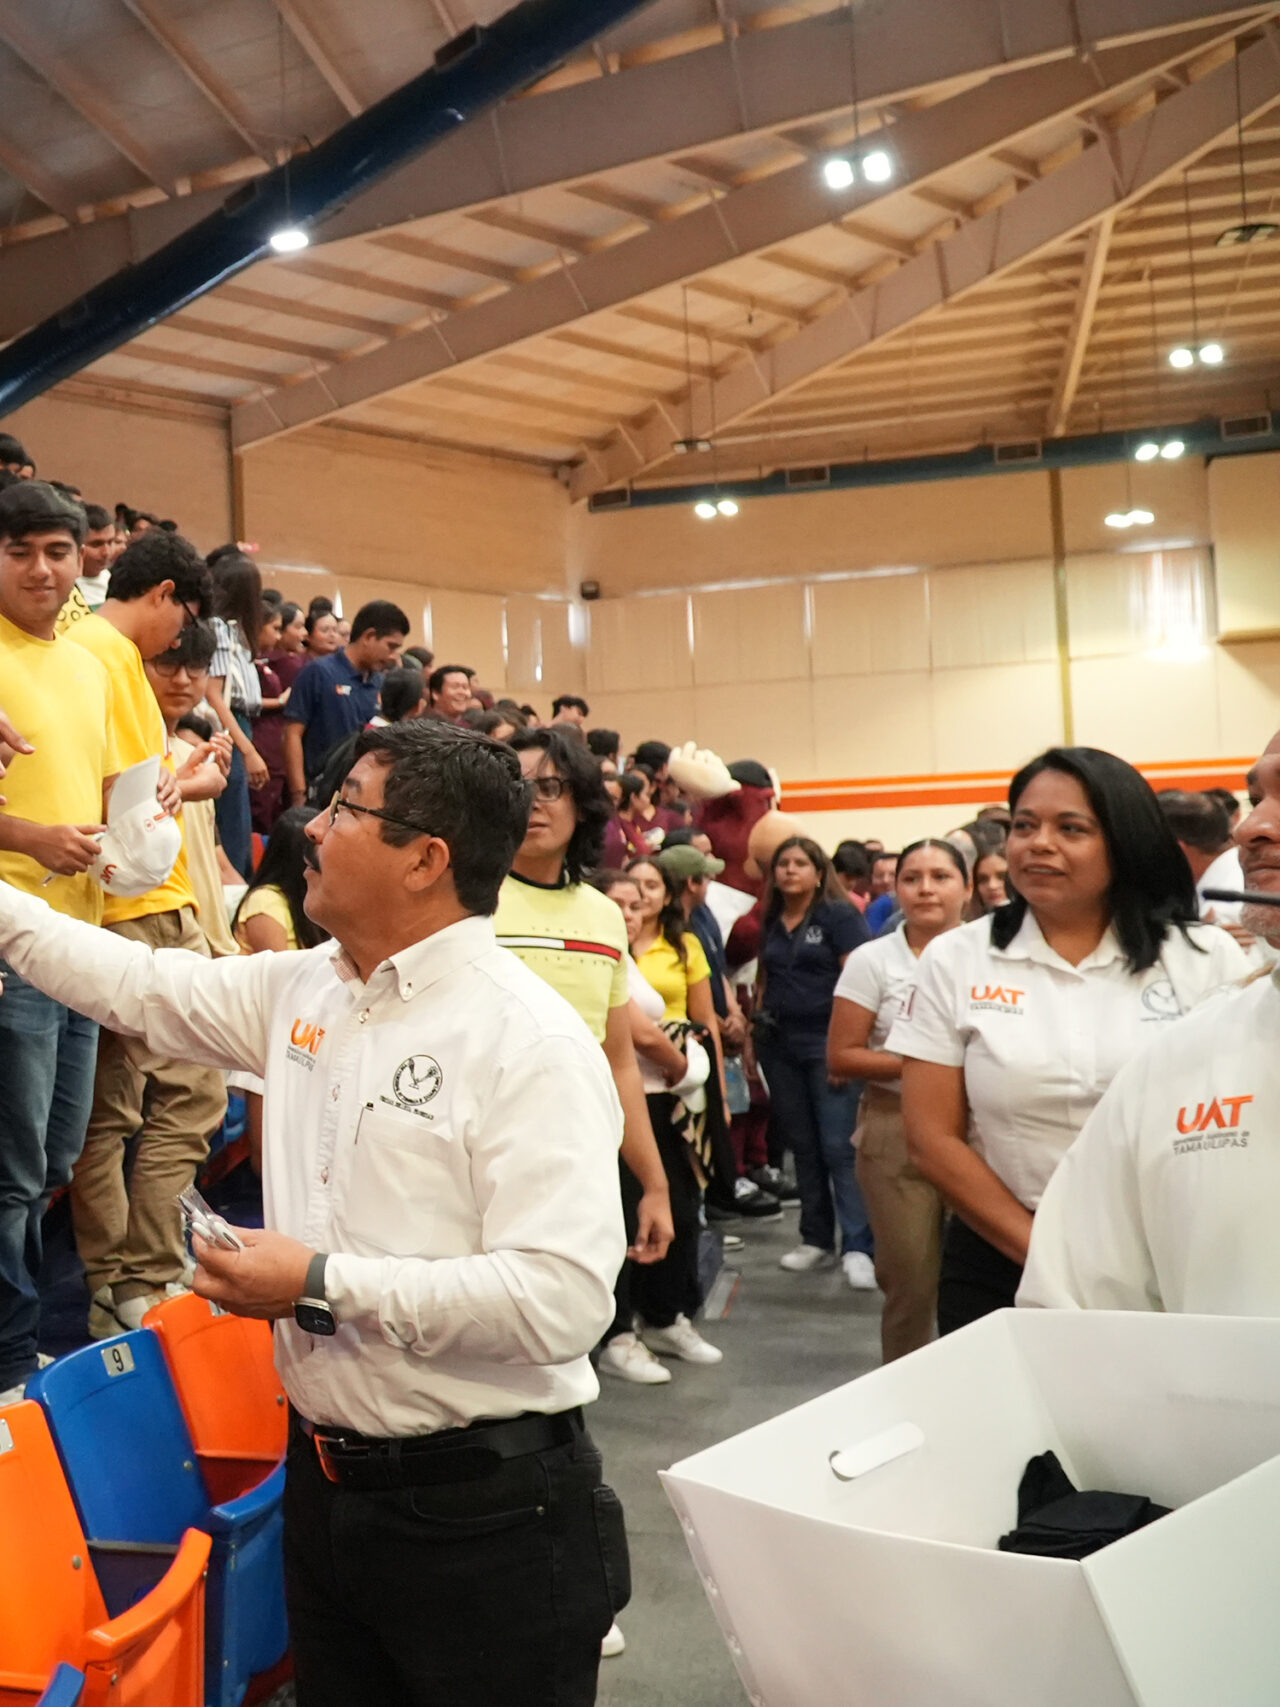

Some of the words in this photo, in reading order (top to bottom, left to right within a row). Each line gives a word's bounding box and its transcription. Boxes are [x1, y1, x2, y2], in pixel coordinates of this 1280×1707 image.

[970, 984, 1026, 1006] UAT
[1176, 1094, 1255, 1135] UAT
[112, 1348, 124, 1372] 9
